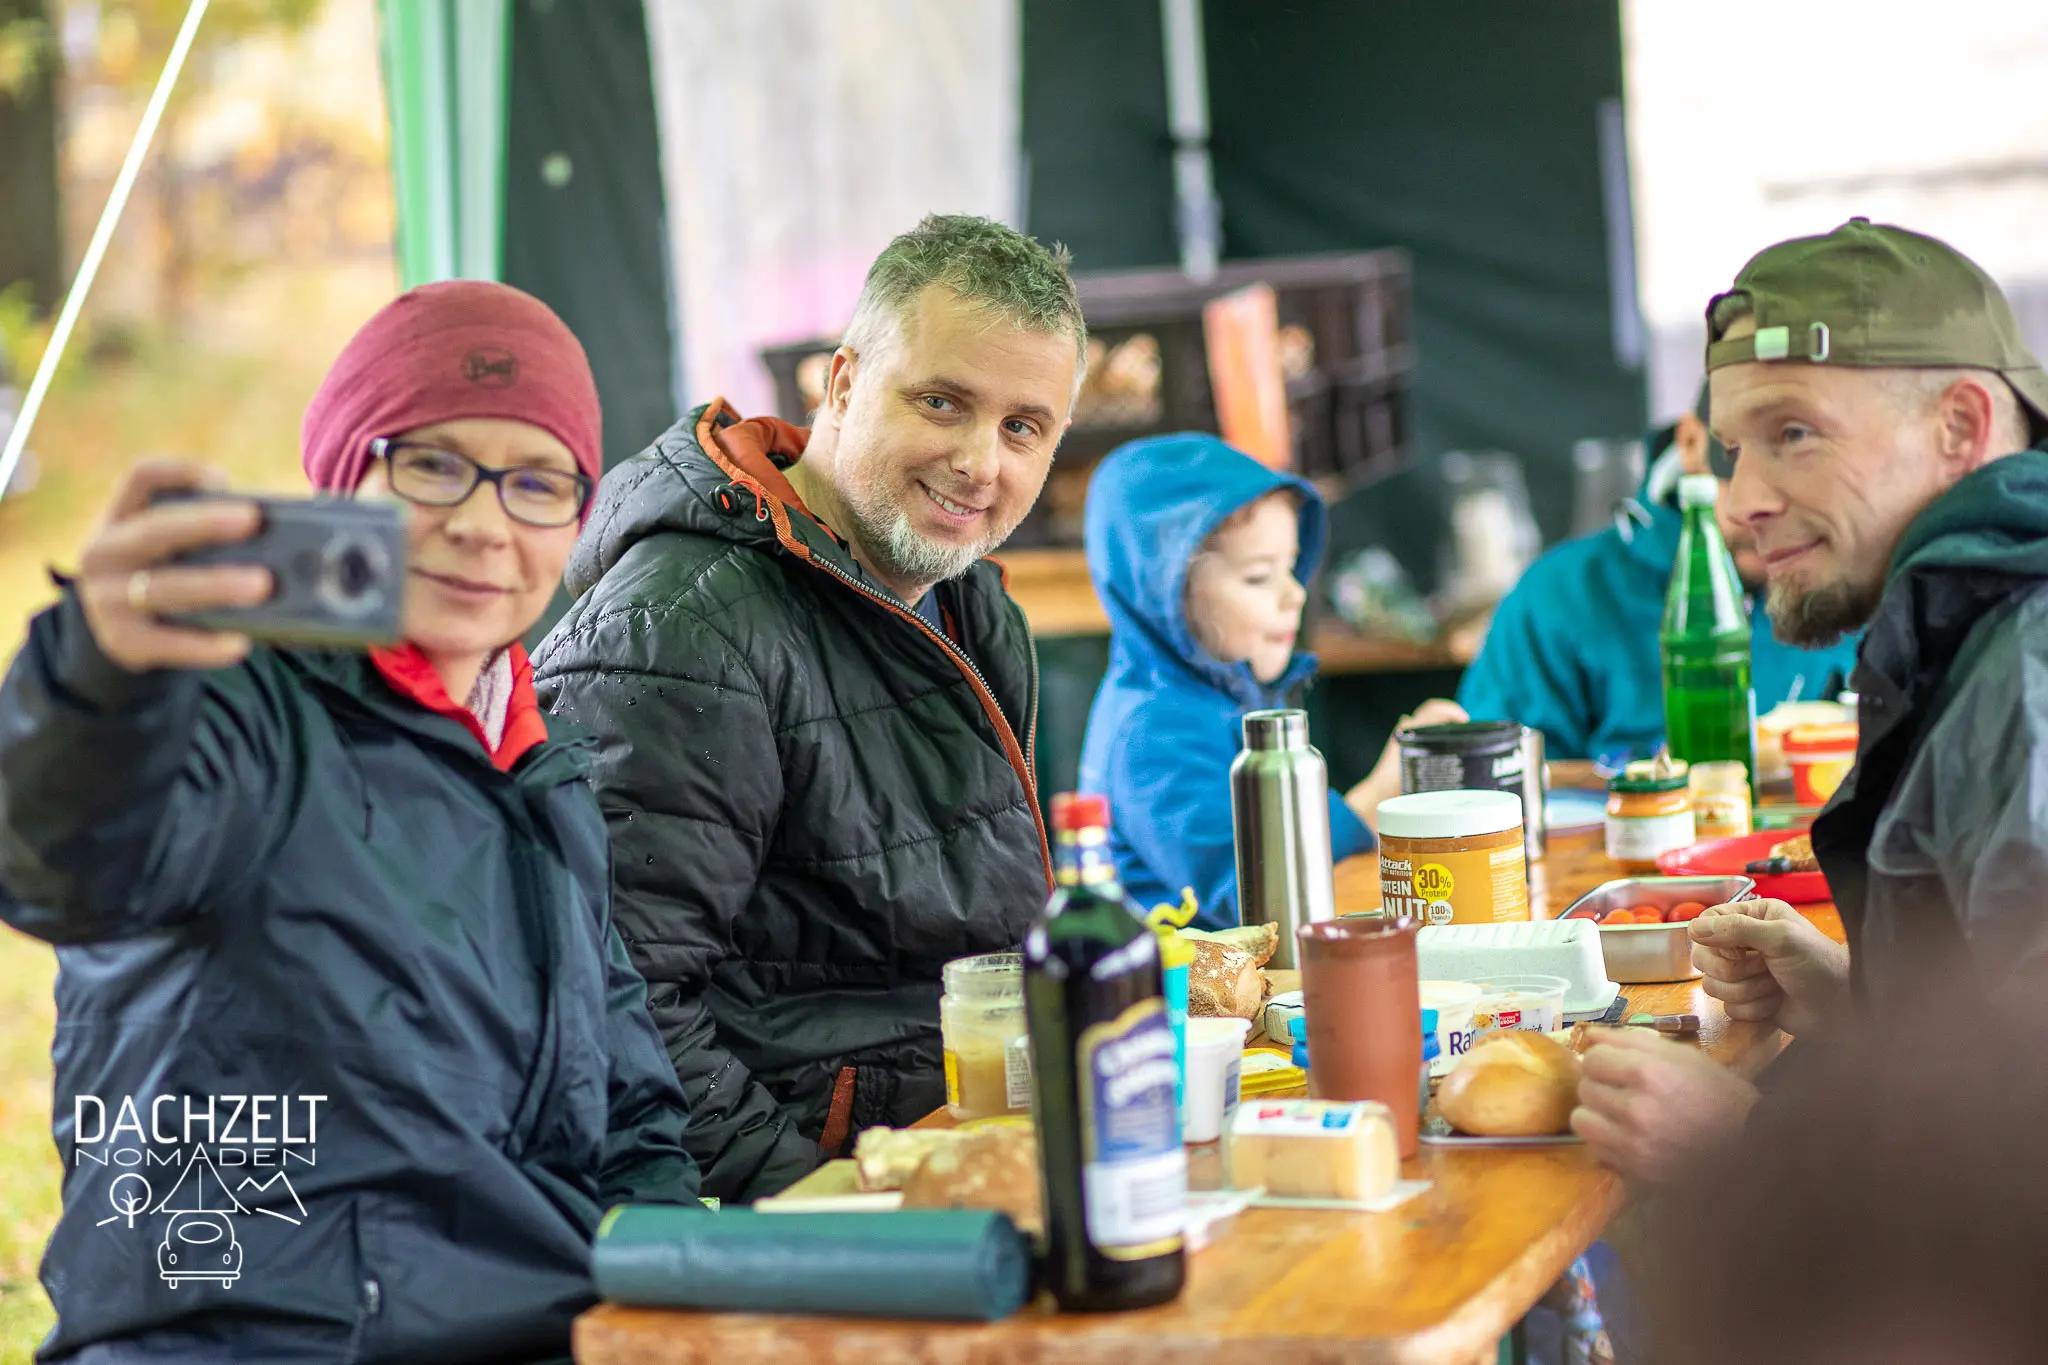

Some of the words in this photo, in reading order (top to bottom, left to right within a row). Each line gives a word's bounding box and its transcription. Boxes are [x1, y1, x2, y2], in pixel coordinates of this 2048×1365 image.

[1418, 869, 1452, 889] 30%
[1421, 888, 1448, 897] Protein
[1382, 896, 1427, 921] NUT
